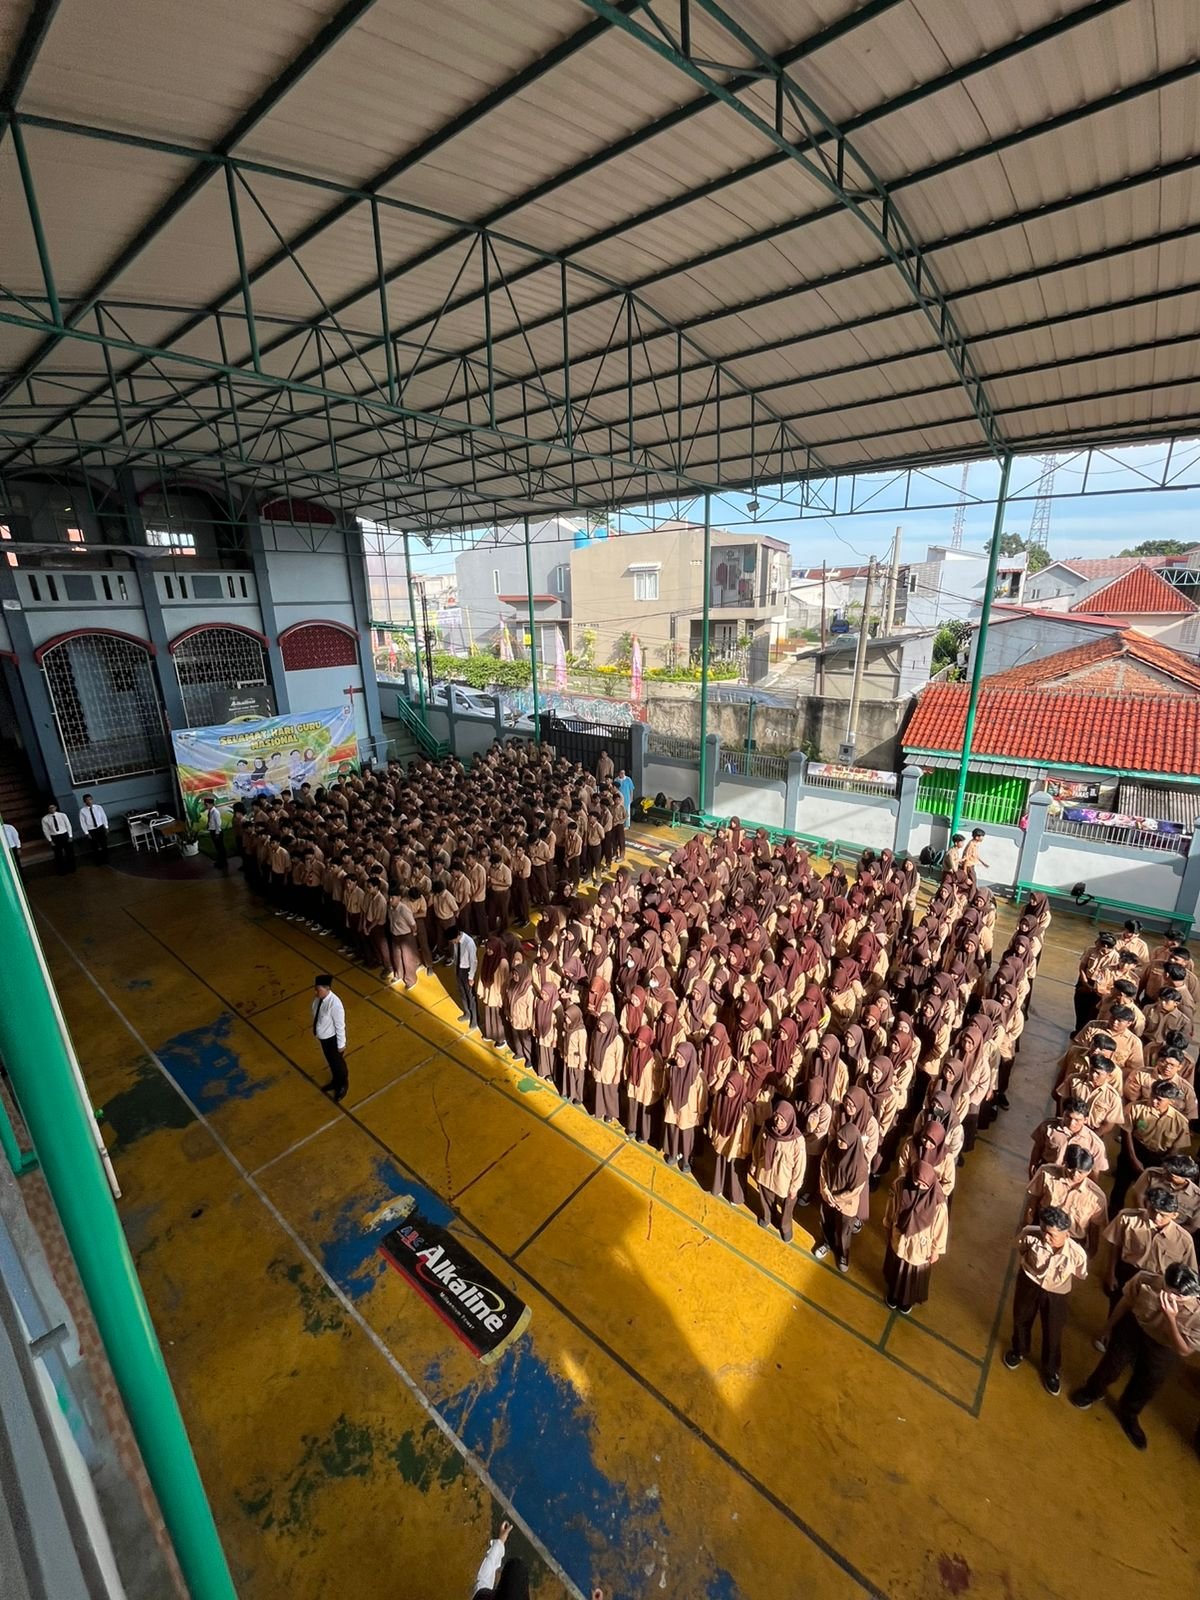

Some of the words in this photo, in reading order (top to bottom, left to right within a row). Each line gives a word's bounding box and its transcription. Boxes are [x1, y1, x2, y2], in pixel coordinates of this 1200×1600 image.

[219, 730, 268, 746] SELAMAT
[271, 726, 294, 737] HARI
[296, 721, 321, 733] GURU
[250, 734, 299, 750] NASIONAL
[415, 1244, 504, 1333] Alkaline
